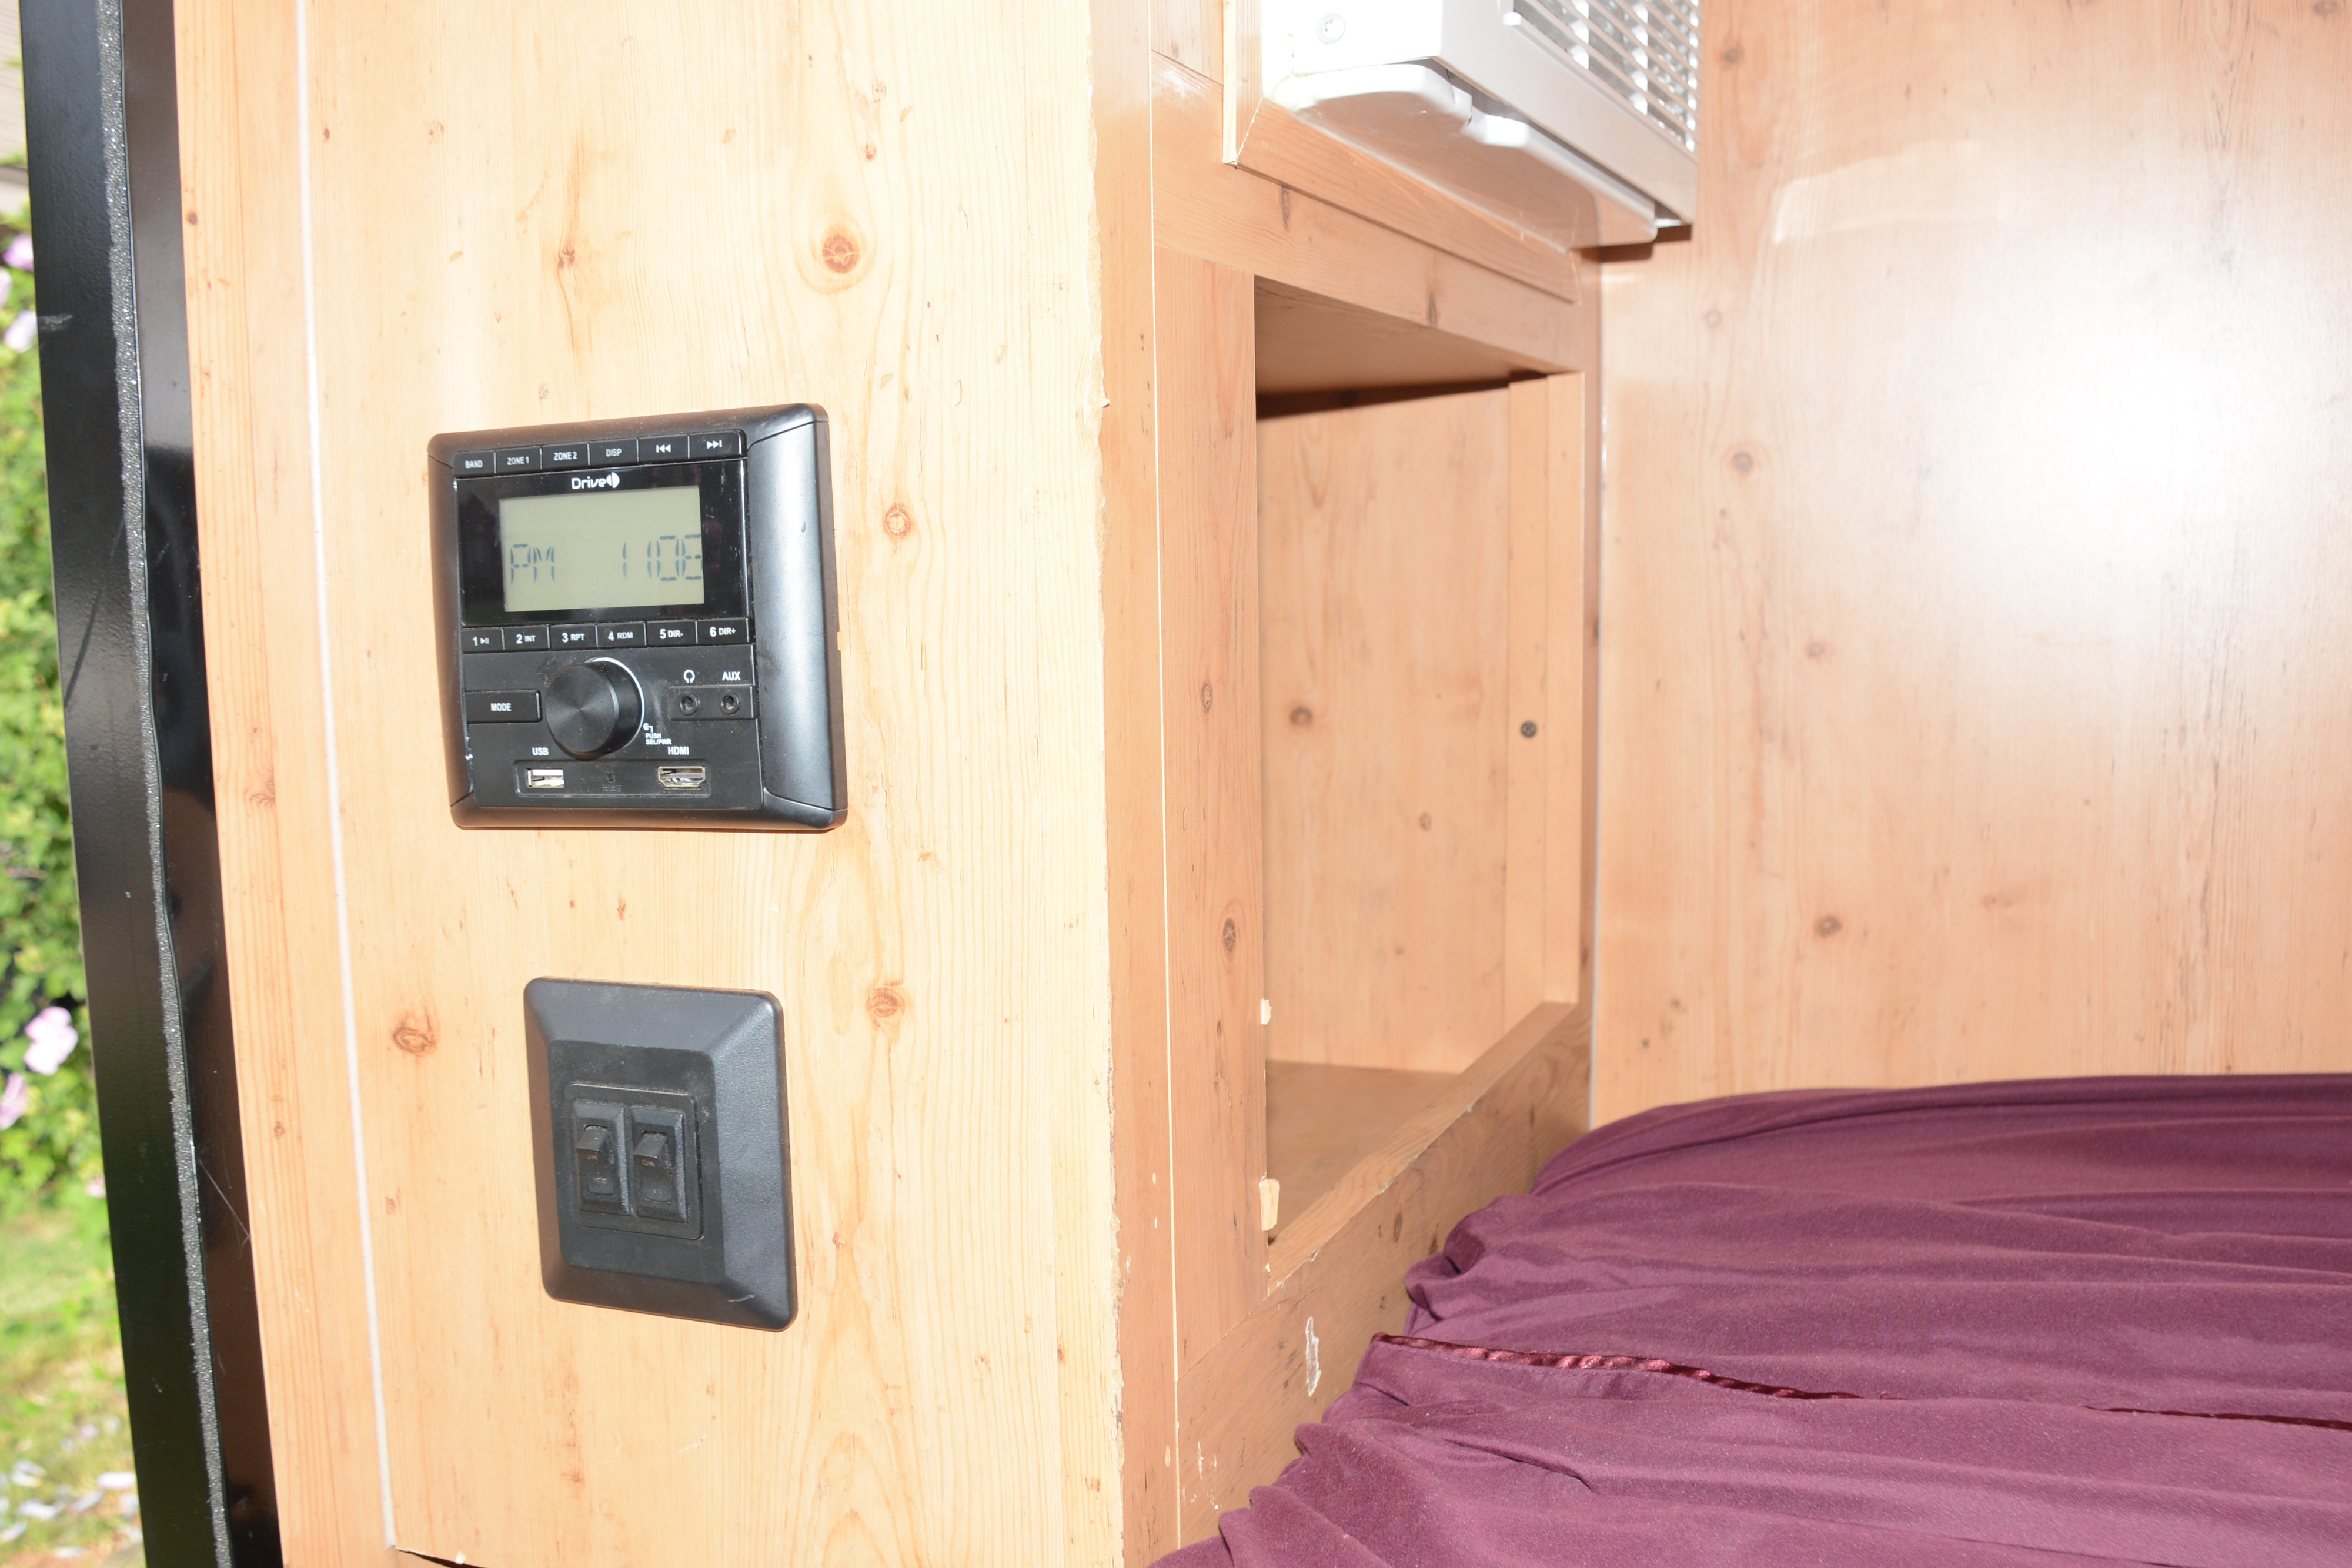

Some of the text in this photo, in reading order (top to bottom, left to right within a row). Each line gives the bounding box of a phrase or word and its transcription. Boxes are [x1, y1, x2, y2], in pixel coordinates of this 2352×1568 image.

[554, 452, 572, 461] ZONE
[606, 448, 622, 457] DISP
[465, 460, 483, 469] BAND
[507, 456, 529, 466] ZONE 1
[510, 543, 555, 585] PM
[607, 631, 614, 641] 4
[659, 629, 666, 639] 5
[709, 627, 736, 637] 6 DIR+
[472, 636, 478, 646] 1
[516, 634, 523, 644] 2
[562, 633, 569, 643] 3
[722, 671, 741, 681] AUX
[490, 703, 512, 711] MODE
[532, 747, 549, 756] USB
[667, 746, 690, 755] HDMI
